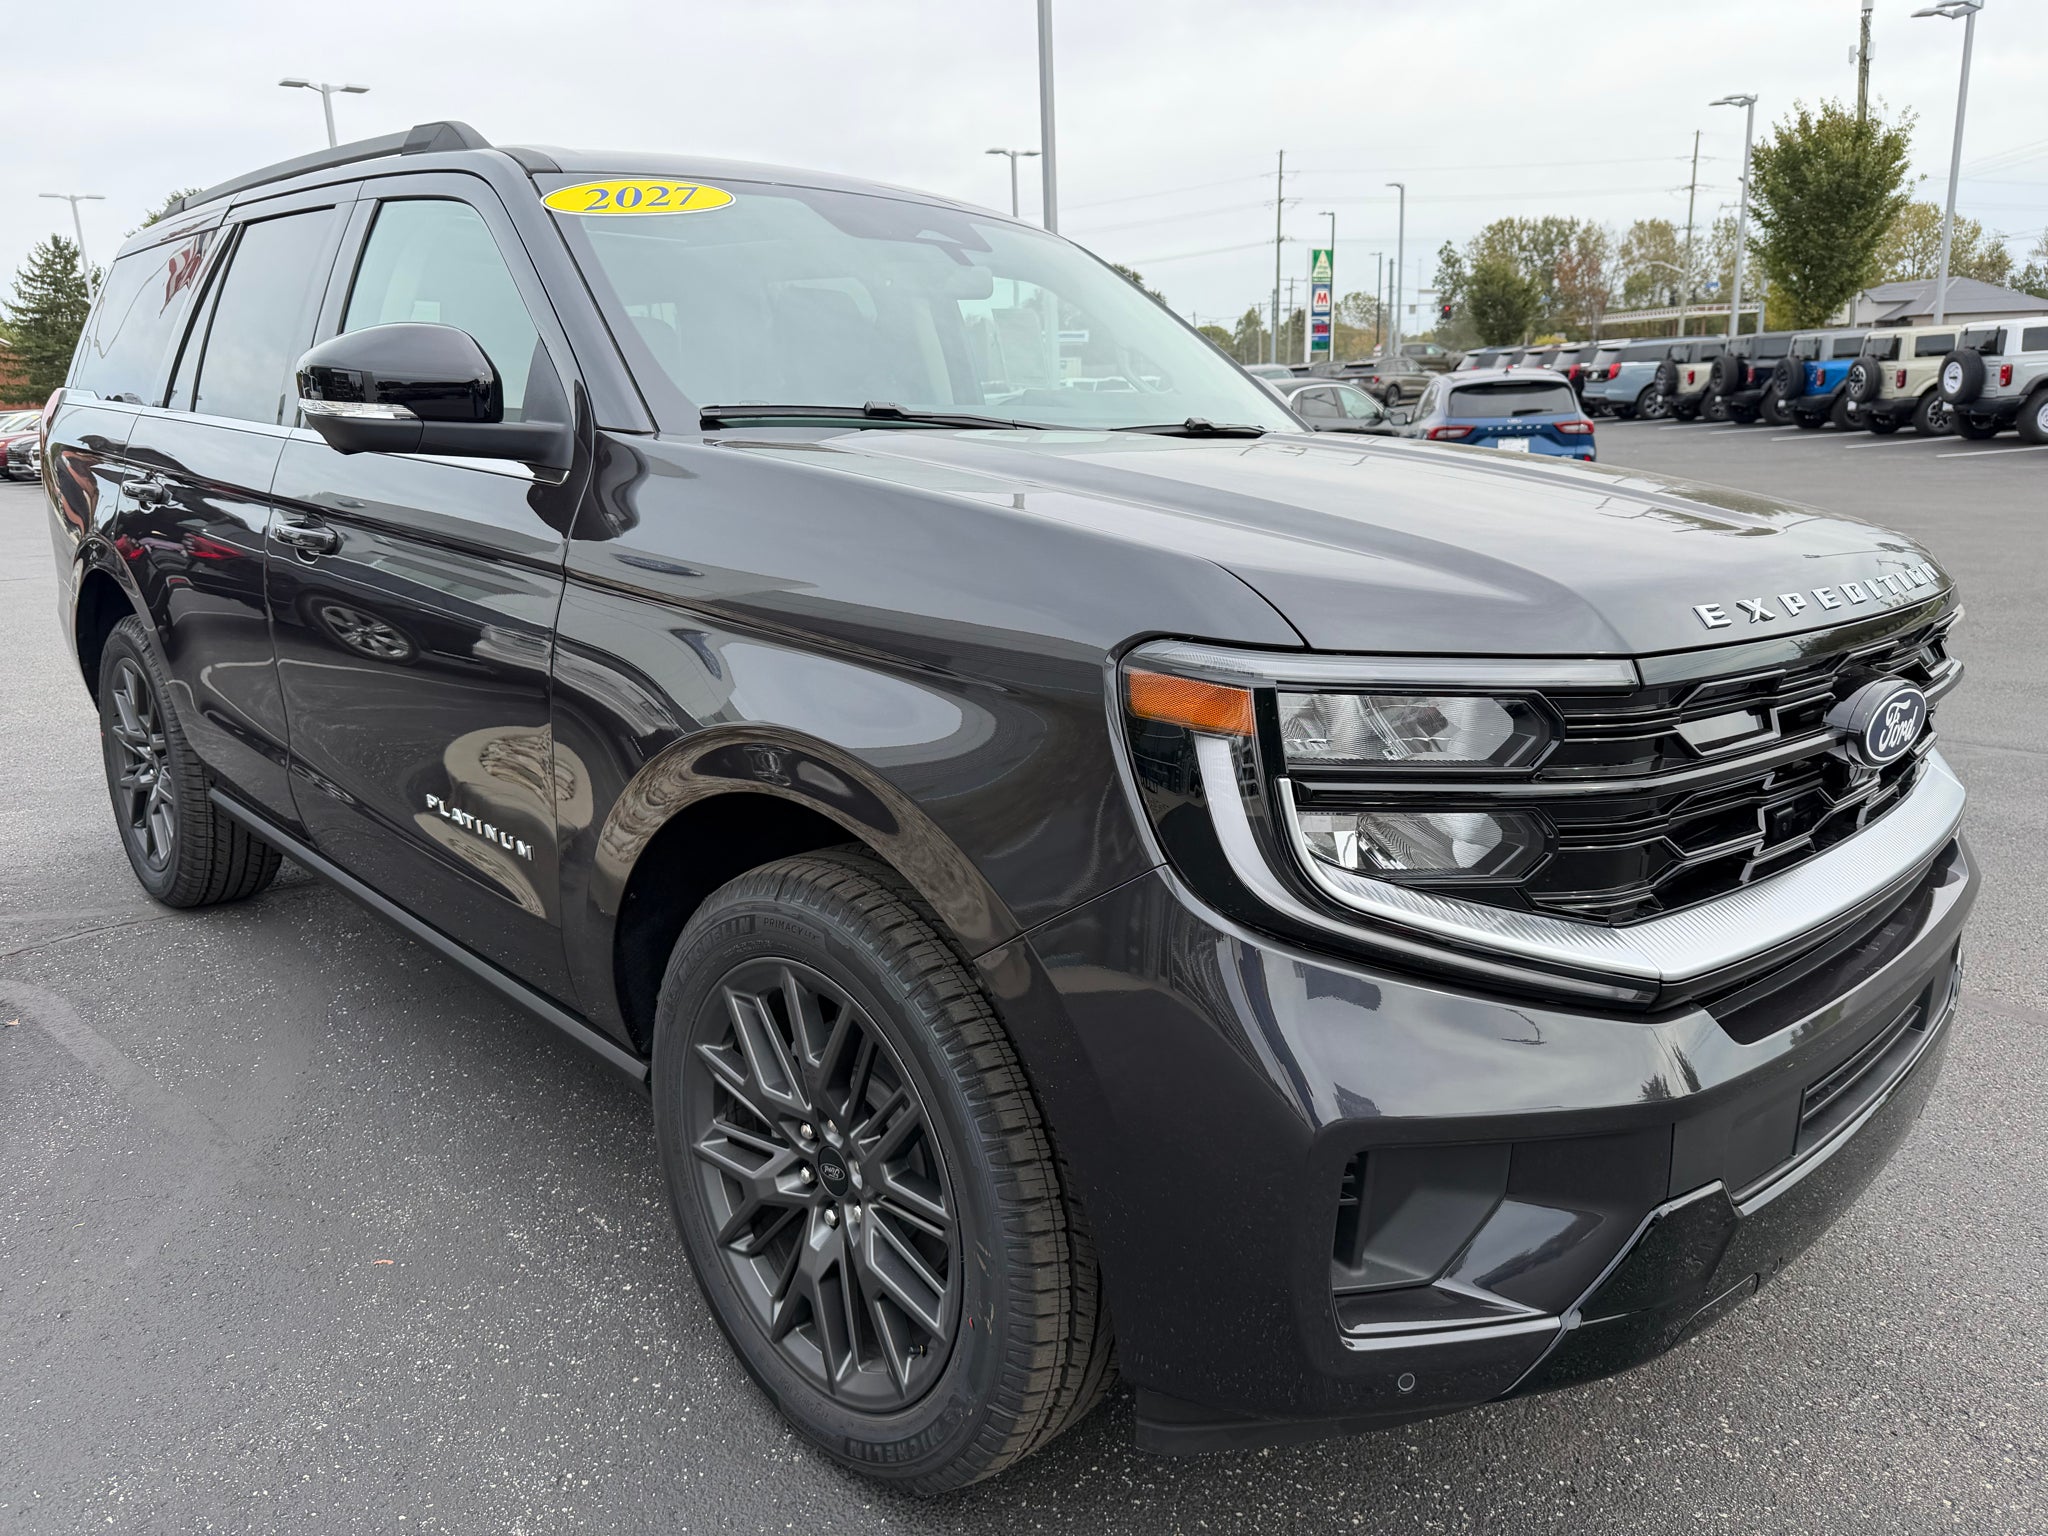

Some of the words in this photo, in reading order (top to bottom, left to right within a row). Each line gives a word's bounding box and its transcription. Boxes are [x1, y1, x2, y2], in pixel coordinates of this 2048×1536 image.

[583, 186, 699, 211] 2027
[1692, 562, 1941, 630] EXPEDITION
[1878, 698, 1919, 753] Ford
[426, 793, 534, 861] PLATINUM
[678, 916, 751, 985] MICHELIN
[763, 917, 803, 935] PRIMACY
[848, 1421, 944, 1463] MICHELIN
